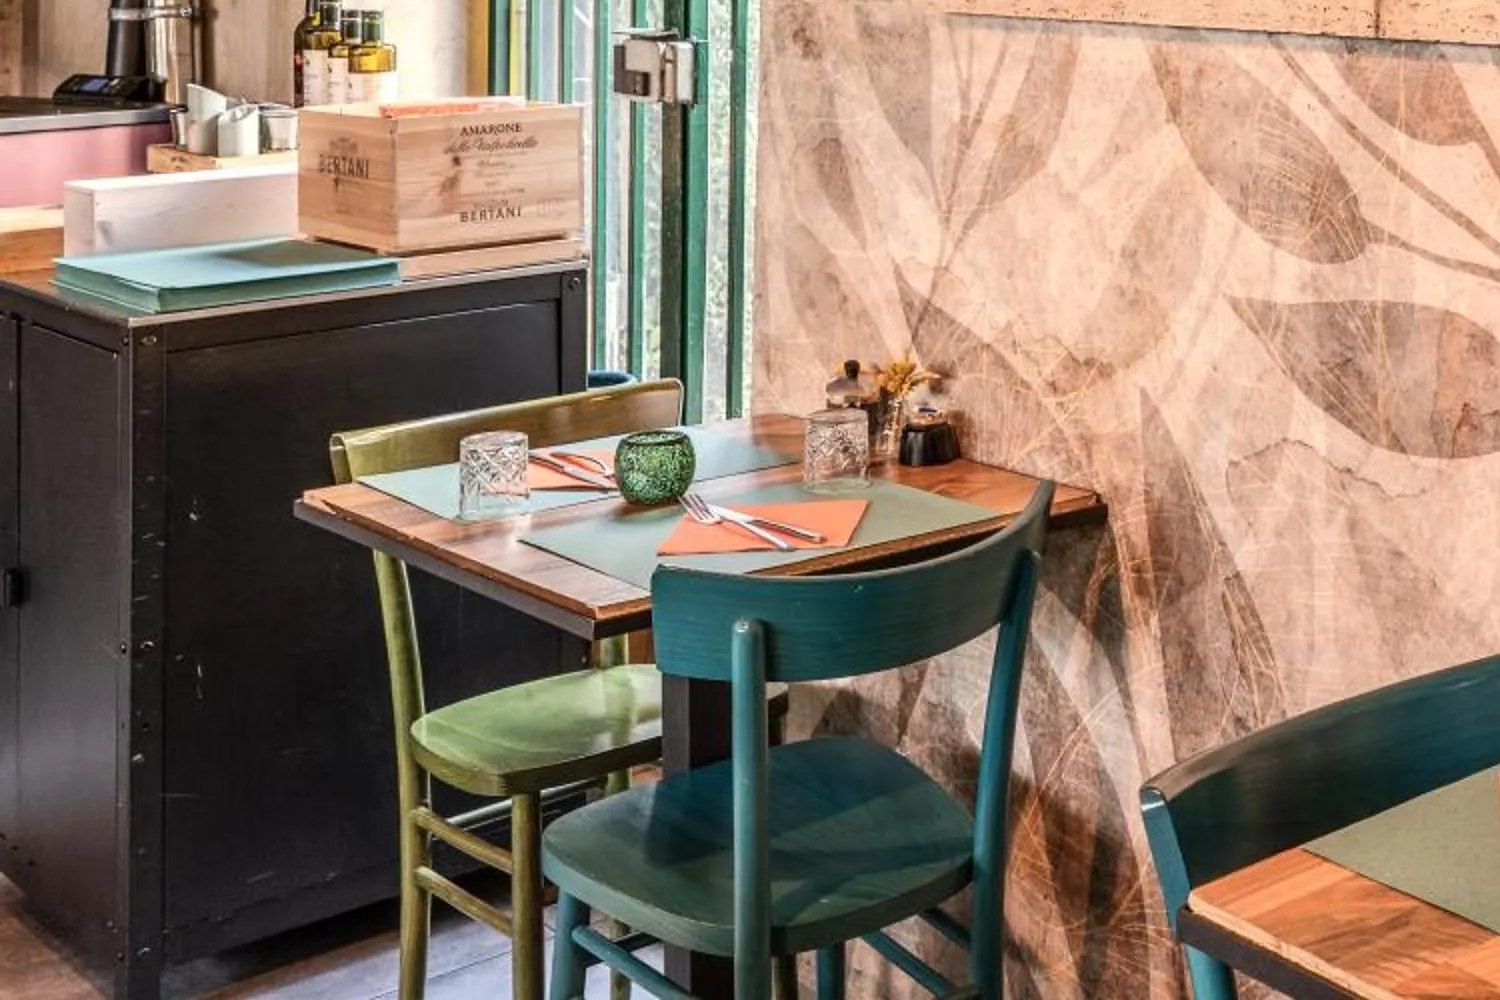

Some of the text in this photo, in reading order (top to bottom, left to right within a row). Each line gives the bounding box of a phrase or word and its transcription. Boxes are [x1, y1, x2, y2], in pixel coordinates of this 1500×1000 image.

[459, 121, 523, 137] AMARONE
[318, 153, 370, 180] BERTANI
[459, 206, 521, 223] BERTANI
